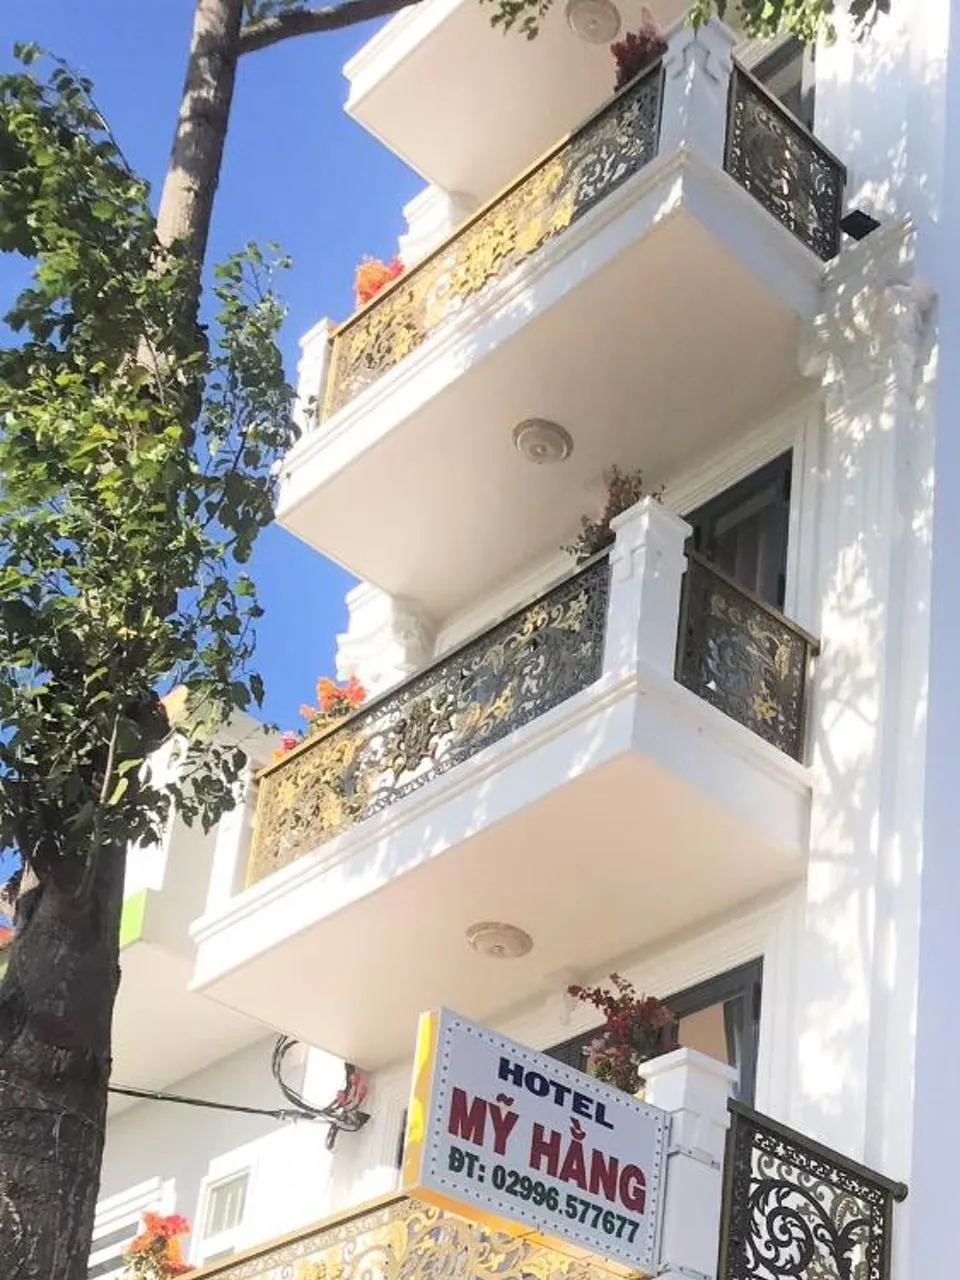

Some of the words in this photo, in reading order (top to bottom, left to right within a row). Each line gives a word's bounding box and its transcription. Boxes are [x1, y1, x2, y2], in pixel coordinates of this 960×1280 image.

[498, 1057, 614, 1130] HOTEL
[448, 1087, 519, 1156] MỸ
[529, 1117, 647, 1215] HẰNG
[448, 1146, 486, 1183] ĐT:
[491, 1165, 640, 1244] 02996.577677
